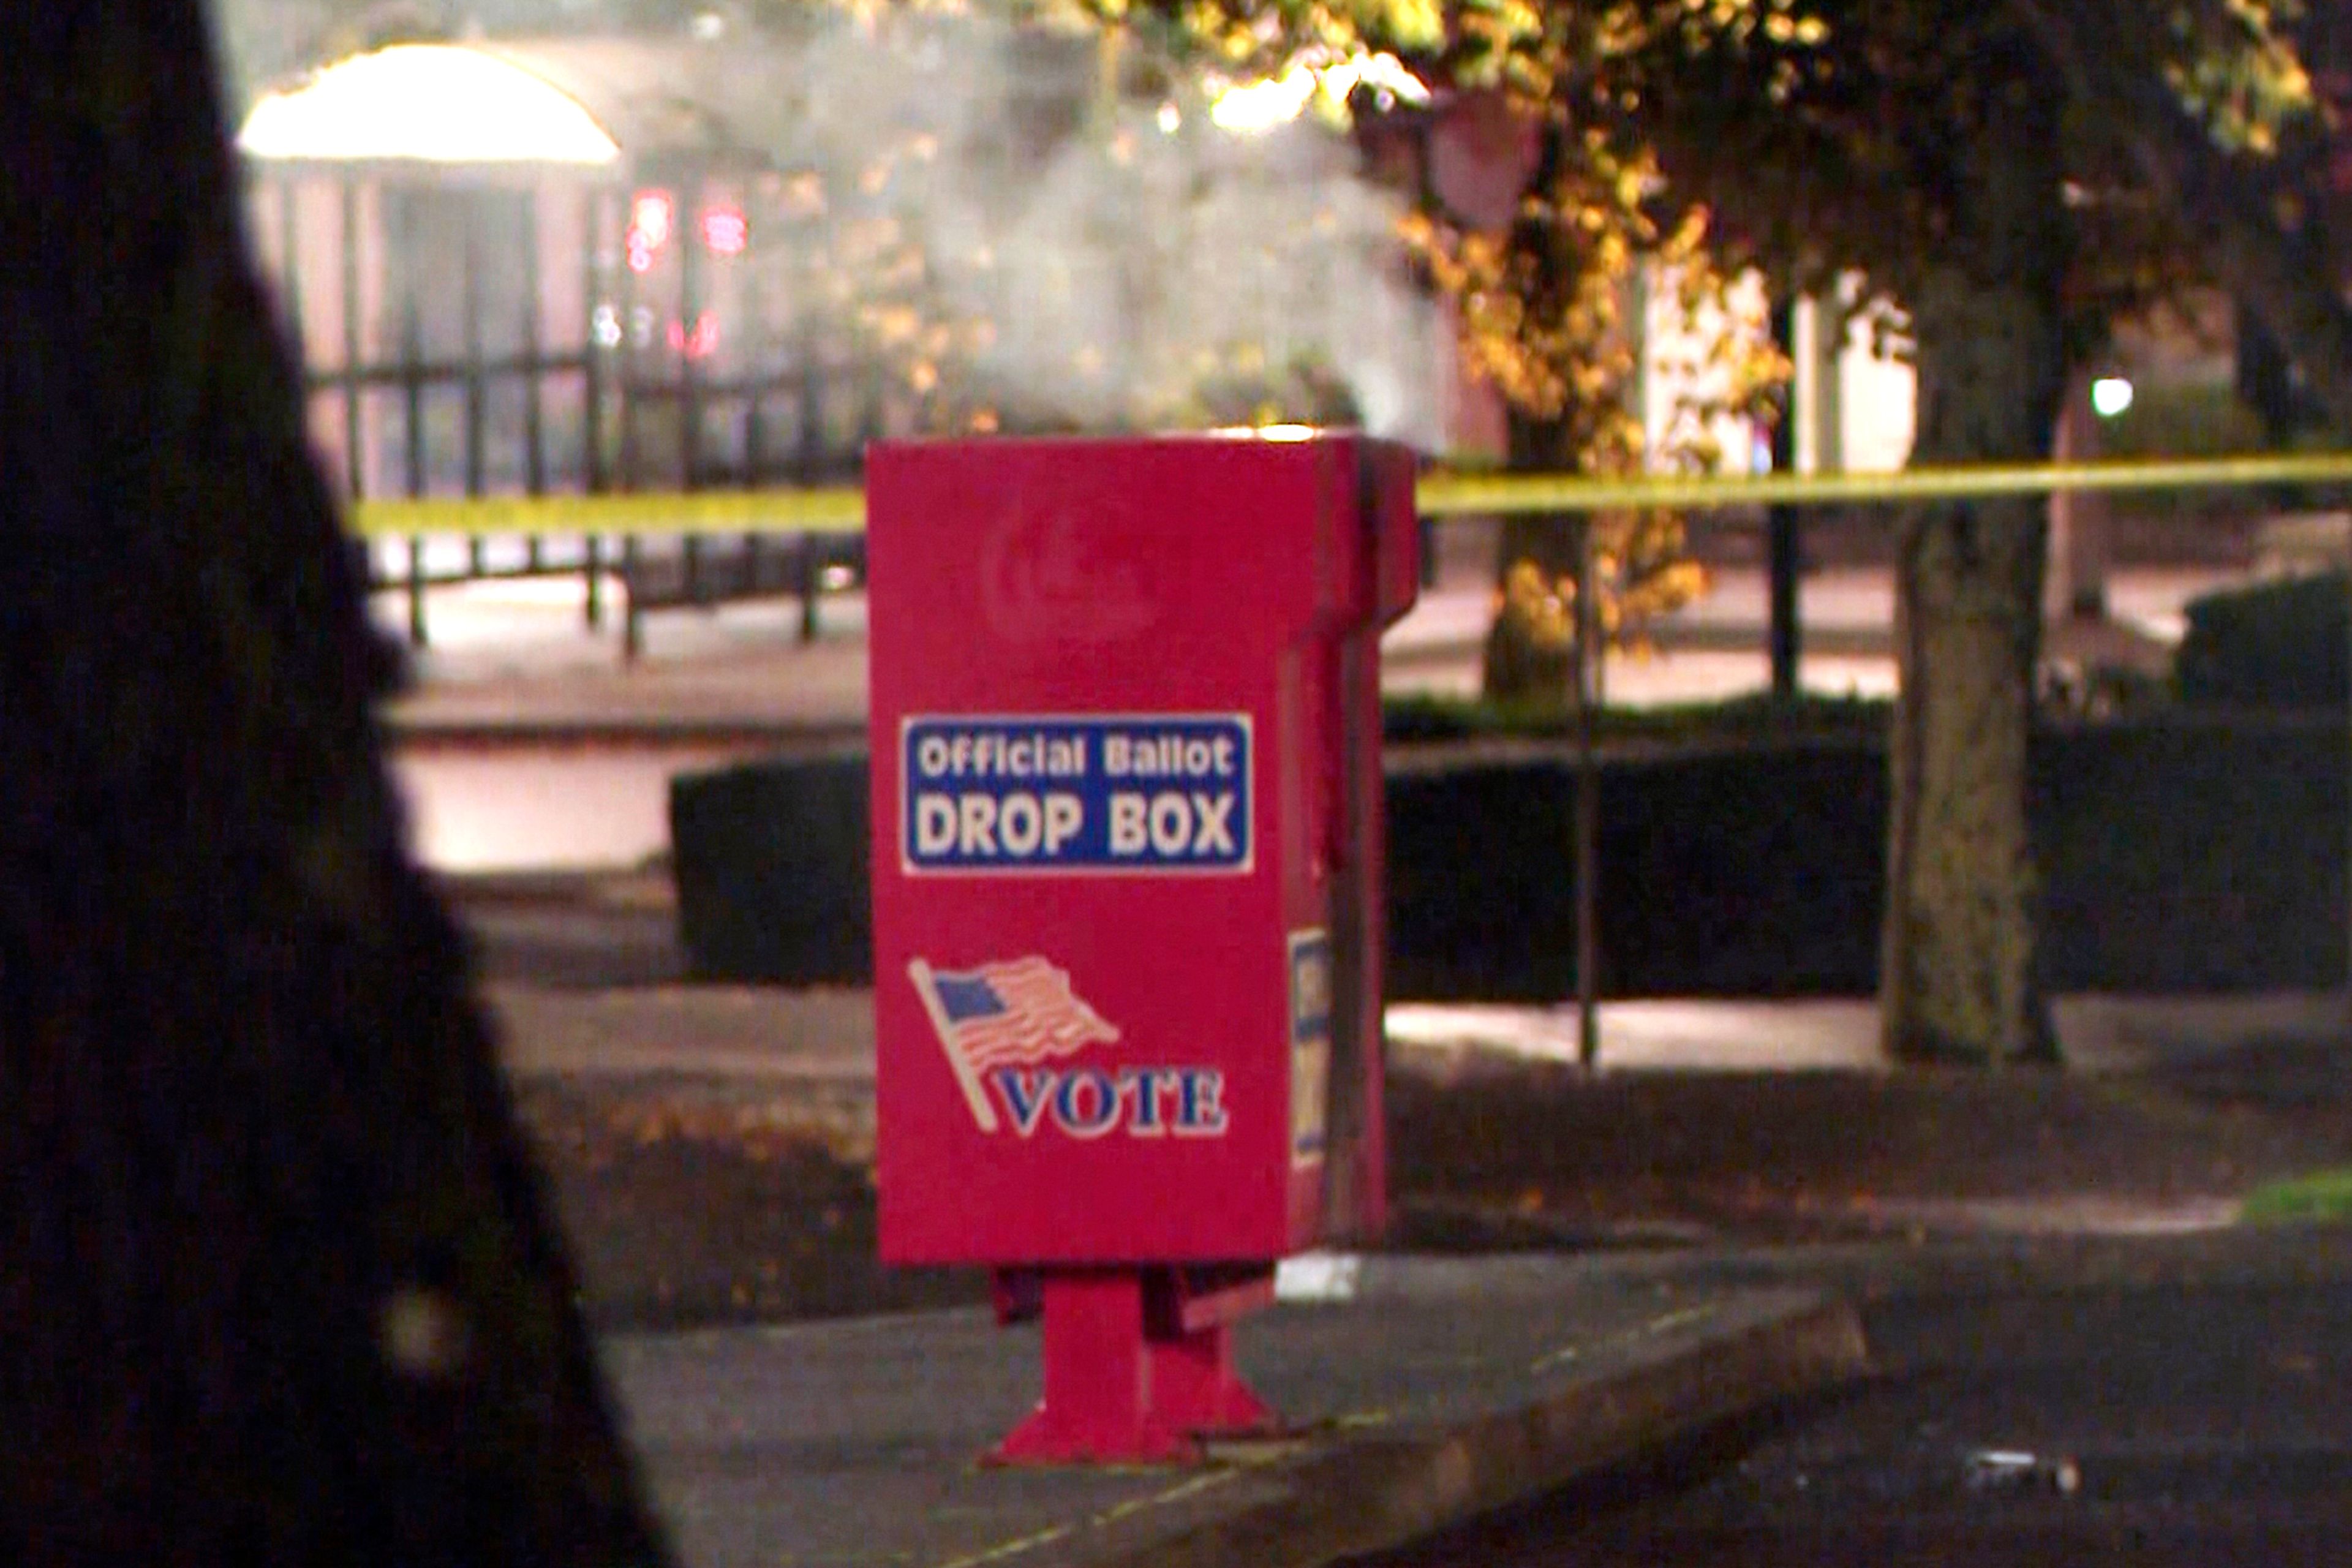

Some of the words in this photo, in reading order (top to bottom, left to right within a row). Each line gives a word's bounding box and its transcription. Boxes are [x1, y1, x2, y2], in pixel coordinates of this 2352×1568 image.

[920, 736, 1085, 777] Official
[1104, 736, 1234, 776] Ballot
[918, 794, 1083, 856] DROP
[1110, 794, 1234, 856] BOX
[992, 1066, 1228, 1138] VOTE
